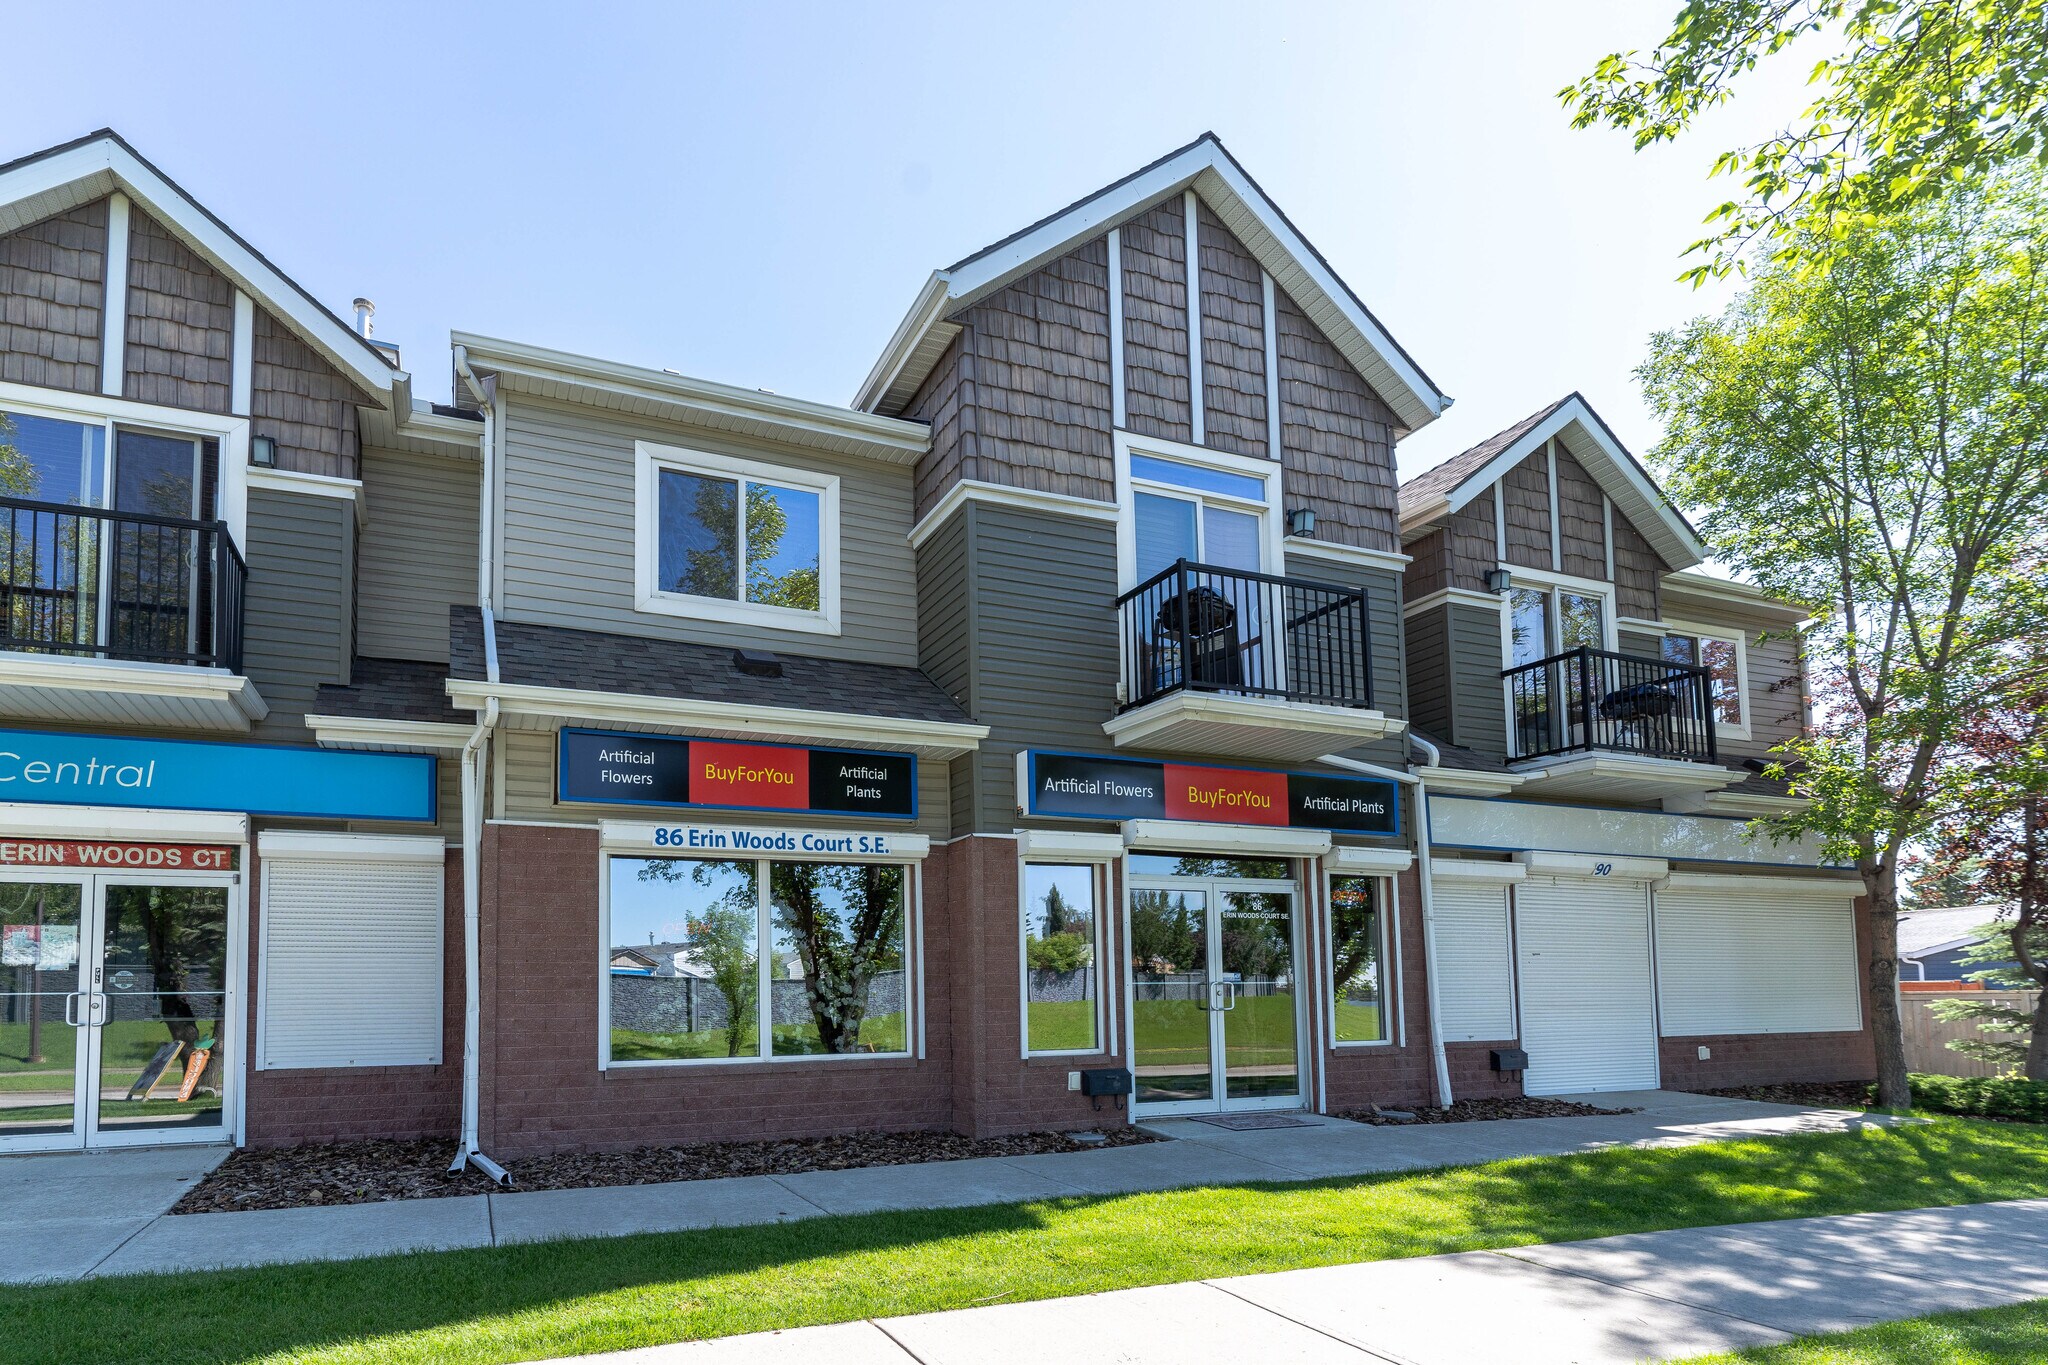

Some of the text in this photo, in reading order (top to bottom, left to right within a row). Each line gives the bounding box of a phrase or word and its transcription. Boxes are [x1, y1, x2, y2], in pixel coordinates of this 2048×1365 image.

[598, 749, 655, 765] Artificial
[0, 752, 156, 788] Central
[601, 770, 653, 785] Flowers
[705, 763, 795, 785] BuyForYou
[839, 765, 888, 781] Artificial
[846, 785, 882, 799] Plants
[1044, 777, 1154, 798] Artificial Flowers
[1188, 786, 1271, 808] BuyForYou
[1303, 796, 1385, 815] Artificial Plants
[655, 827, 890, 854] 86 Erin Woods Court S.E.
[0, 842, 227, 868] ERIN WOODS CT
[1594, 863, 1612, 876] 90
[1252, 902, 1263, 911] 86
[1260, 912, 1281, 920] COURT
